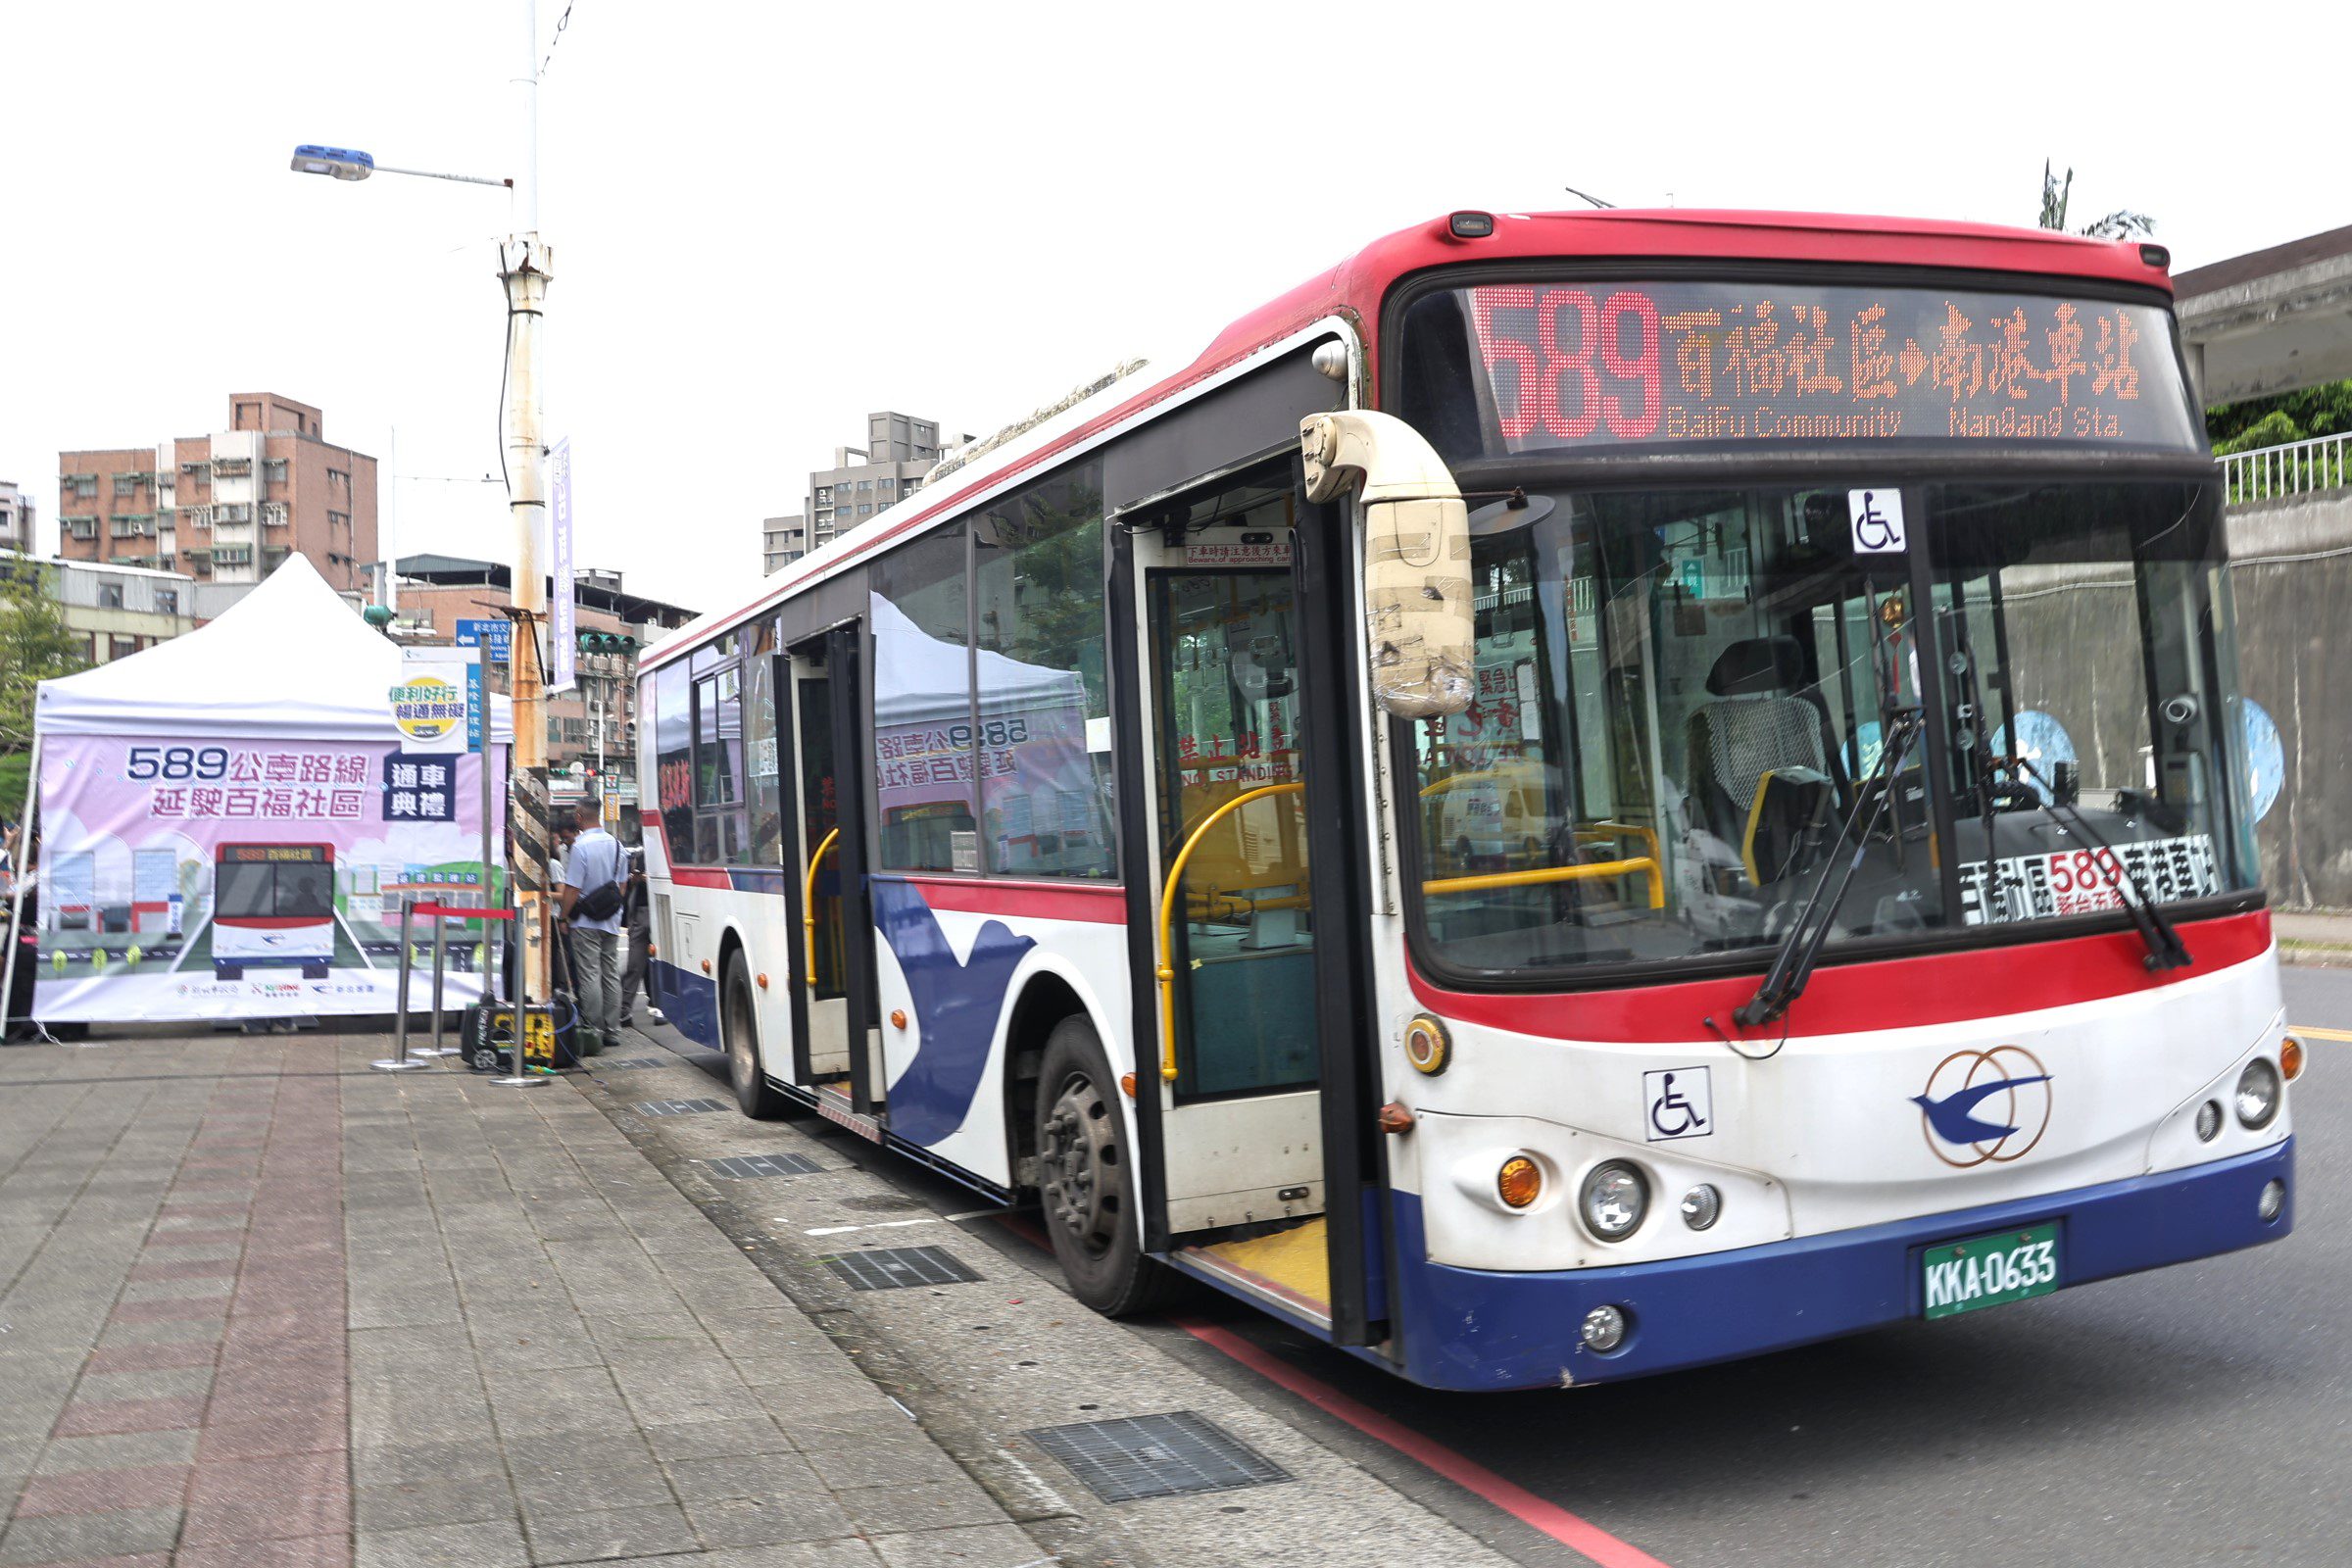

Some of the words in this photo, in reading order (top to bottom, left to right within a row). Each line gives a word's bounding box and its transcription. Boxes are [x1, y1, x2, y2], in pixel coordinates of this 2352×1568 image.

[1472, 287, 1660, 438] 589
[1661, 300, 1897, 403] 百福社區
[1933, 300, 2140, 408] 南港車站
[1667, 406, 1746, 438] BaiFu
[1753, 406, 1902, 438] Community
[1948, 406, 2064, 438] Nangang
[1230, 556, 1273, 564] approaching
[391, 763, 446, 789] 通車
[153, 787, 363, 817] 延駛百福社區
[391, 792, 446, 817] 典禮
[2048, 846, 2123, 894] 589
[1927, 1240, 2056, 1308] KKA-0633
